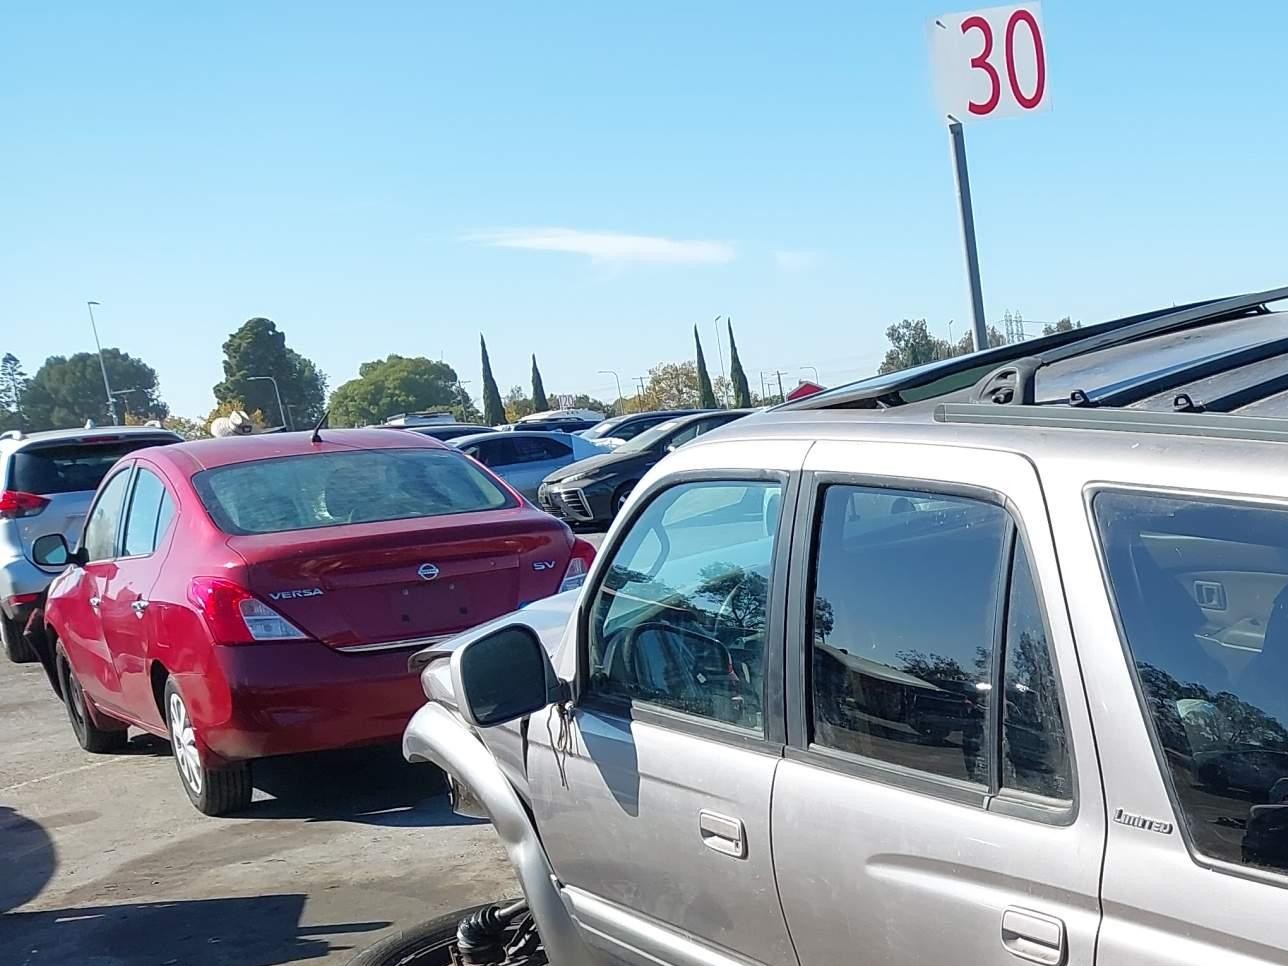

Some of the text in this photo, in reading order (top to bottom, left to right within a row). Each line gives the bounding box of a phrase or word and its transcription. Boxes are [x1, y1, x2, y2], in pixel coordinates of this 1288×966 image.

[960, 9, 1046, 116] 30
[533, 560, 556, 571] SV
[268, 587, 324, 600] VERSA
